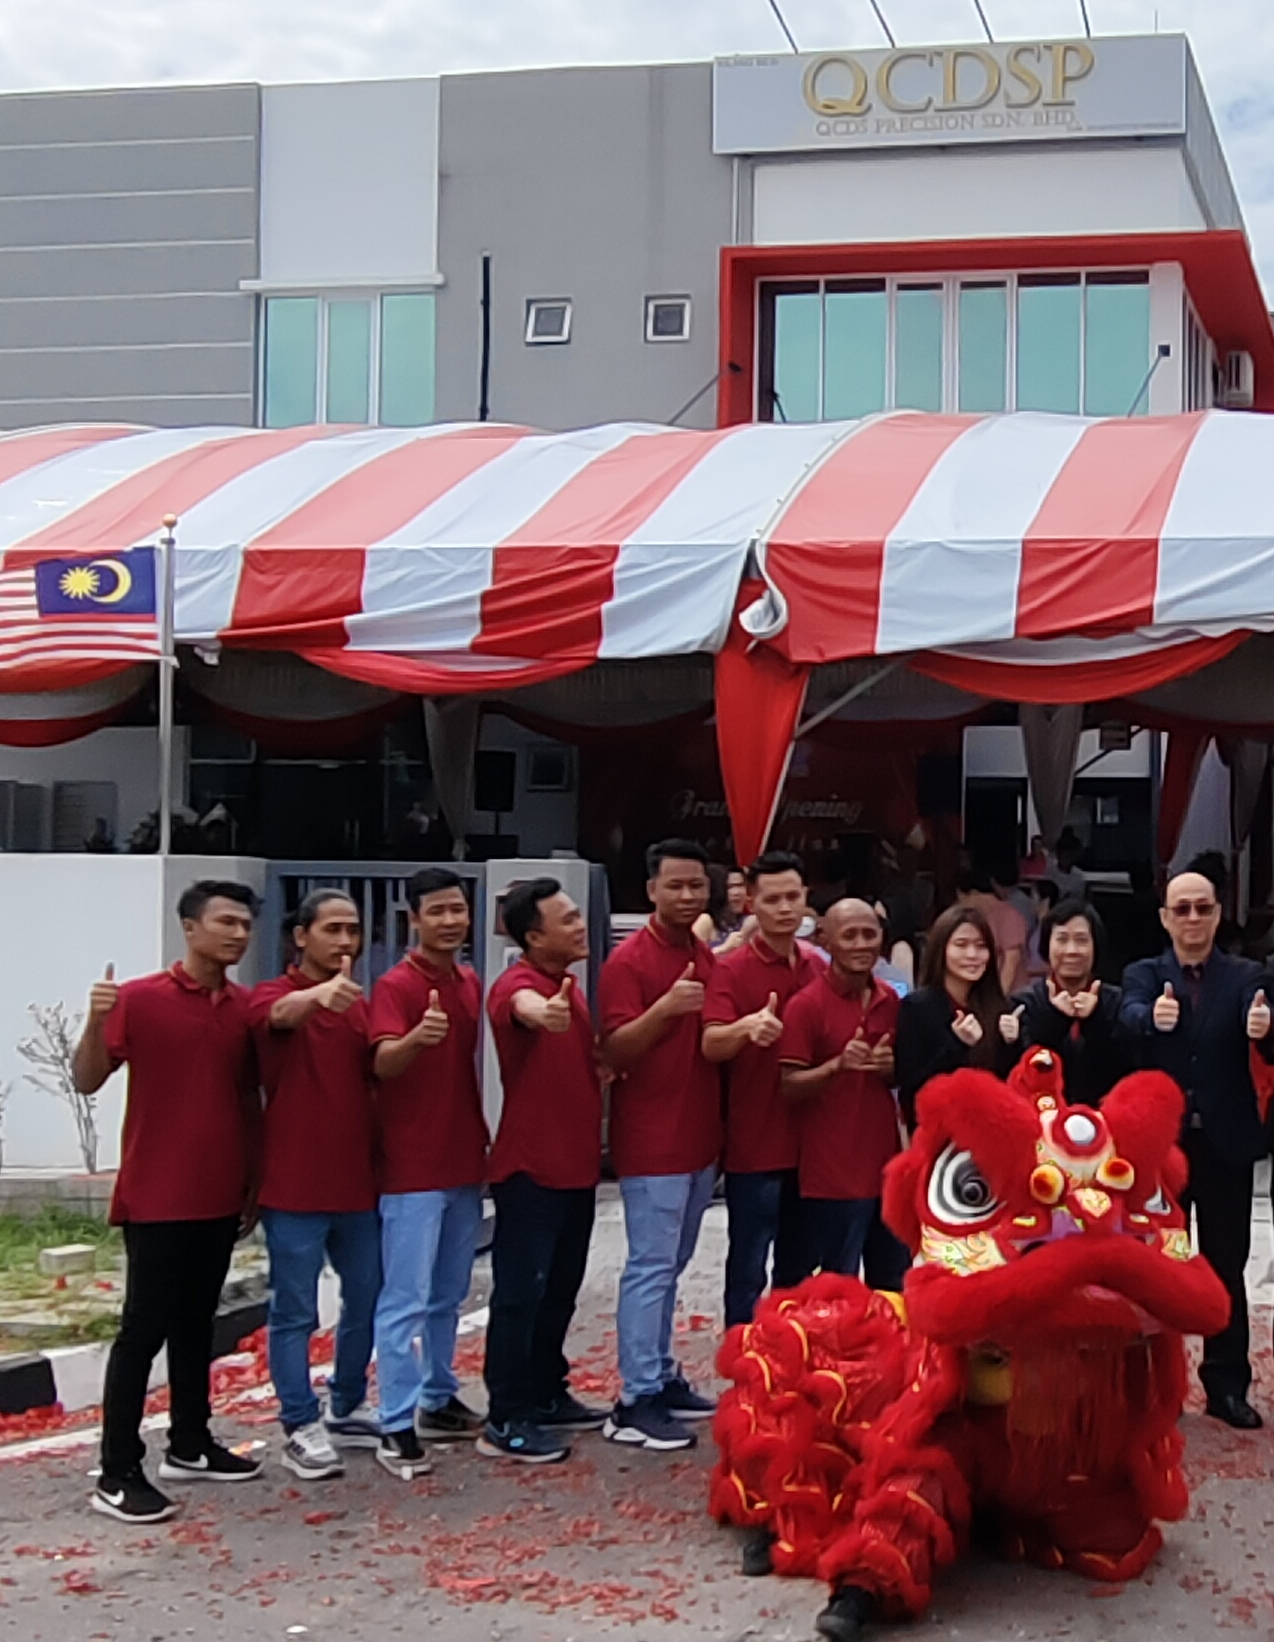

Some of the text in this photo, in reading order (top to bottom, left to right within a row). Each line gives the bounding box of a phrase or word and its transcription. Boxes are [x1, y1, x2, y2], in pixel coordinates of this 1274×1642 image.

[803, 43, 1095, 117] QCDSP
[816, 118, 868, 137] QCDS
[875, 113, 975, 134] PRECISION
[779, 791, 864, 825] pening
